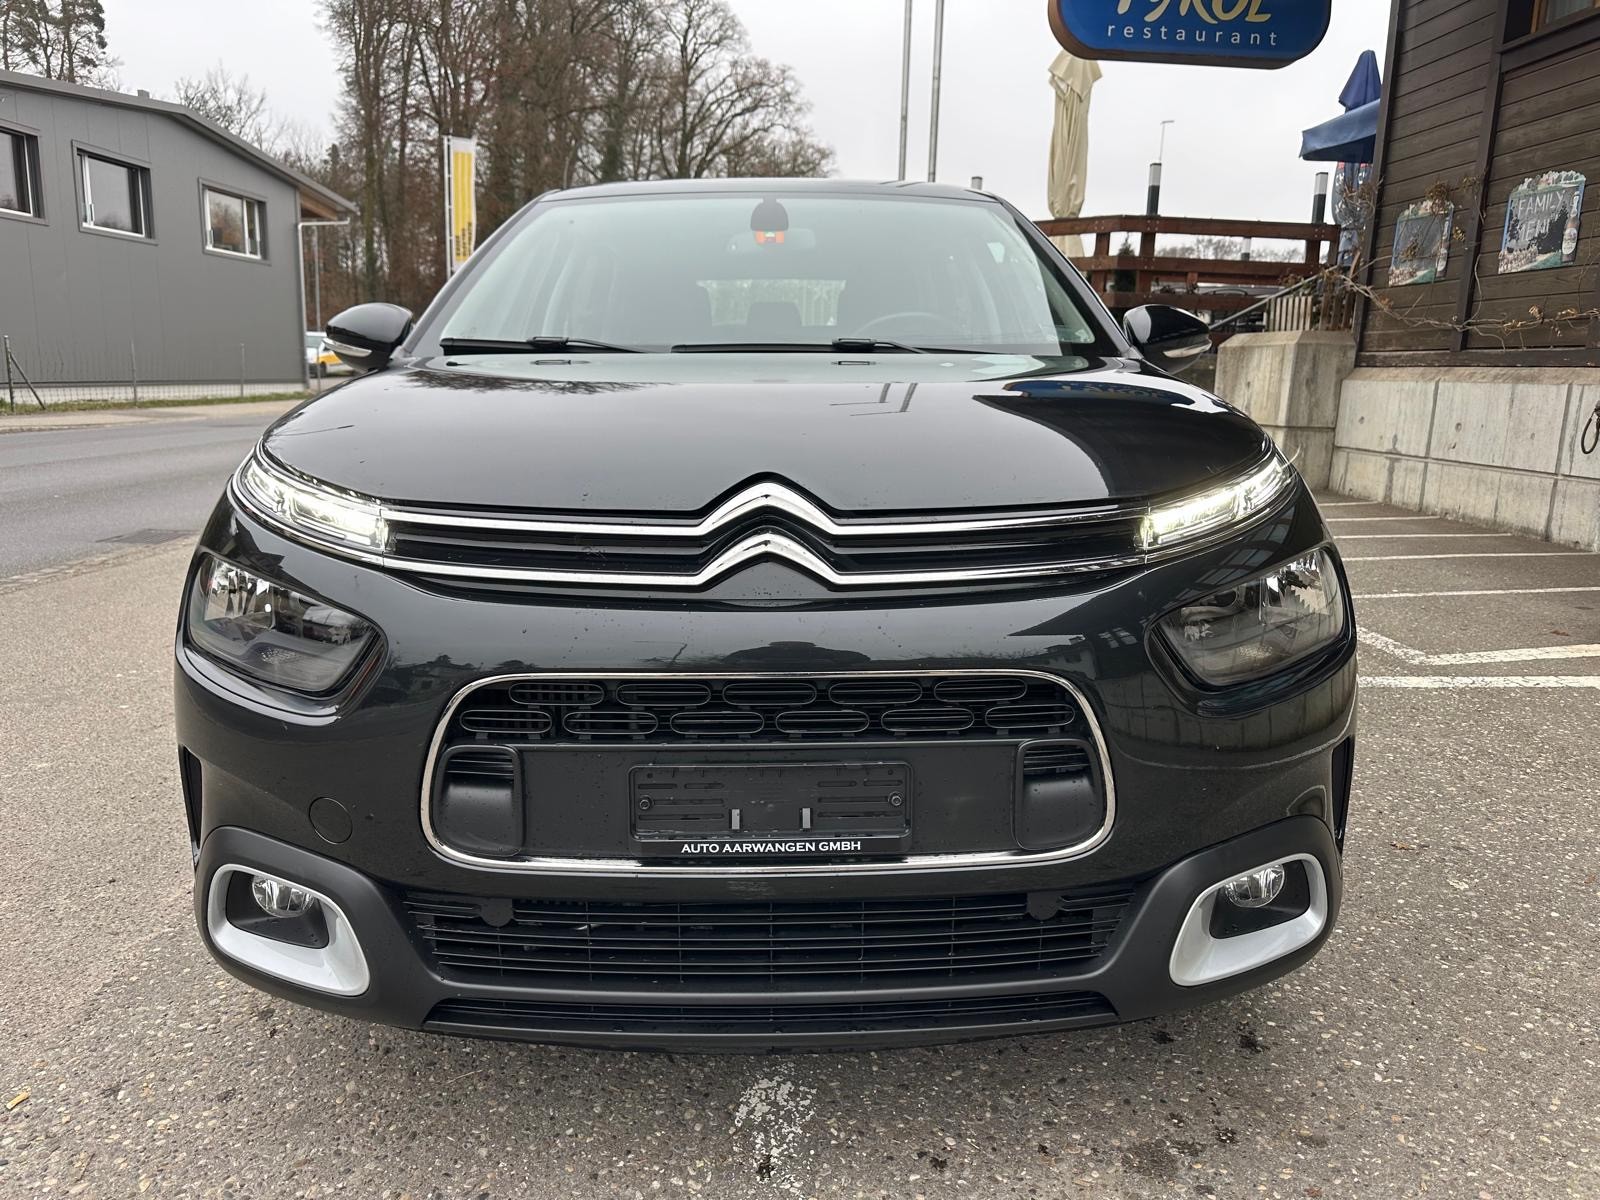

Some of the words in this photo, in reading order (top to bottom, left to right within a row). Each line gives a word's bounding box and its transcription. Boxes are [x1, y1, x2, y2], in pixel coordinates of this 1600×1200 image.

[1108, 25, 1277, 46] restaurant
[1518, 191, 1566, 213] FAMILY
[681, 843, 720, 854] AUTO
[723, 842, 816, 853] AARWANGEN
[818, 841, 861, 852] GMBH
